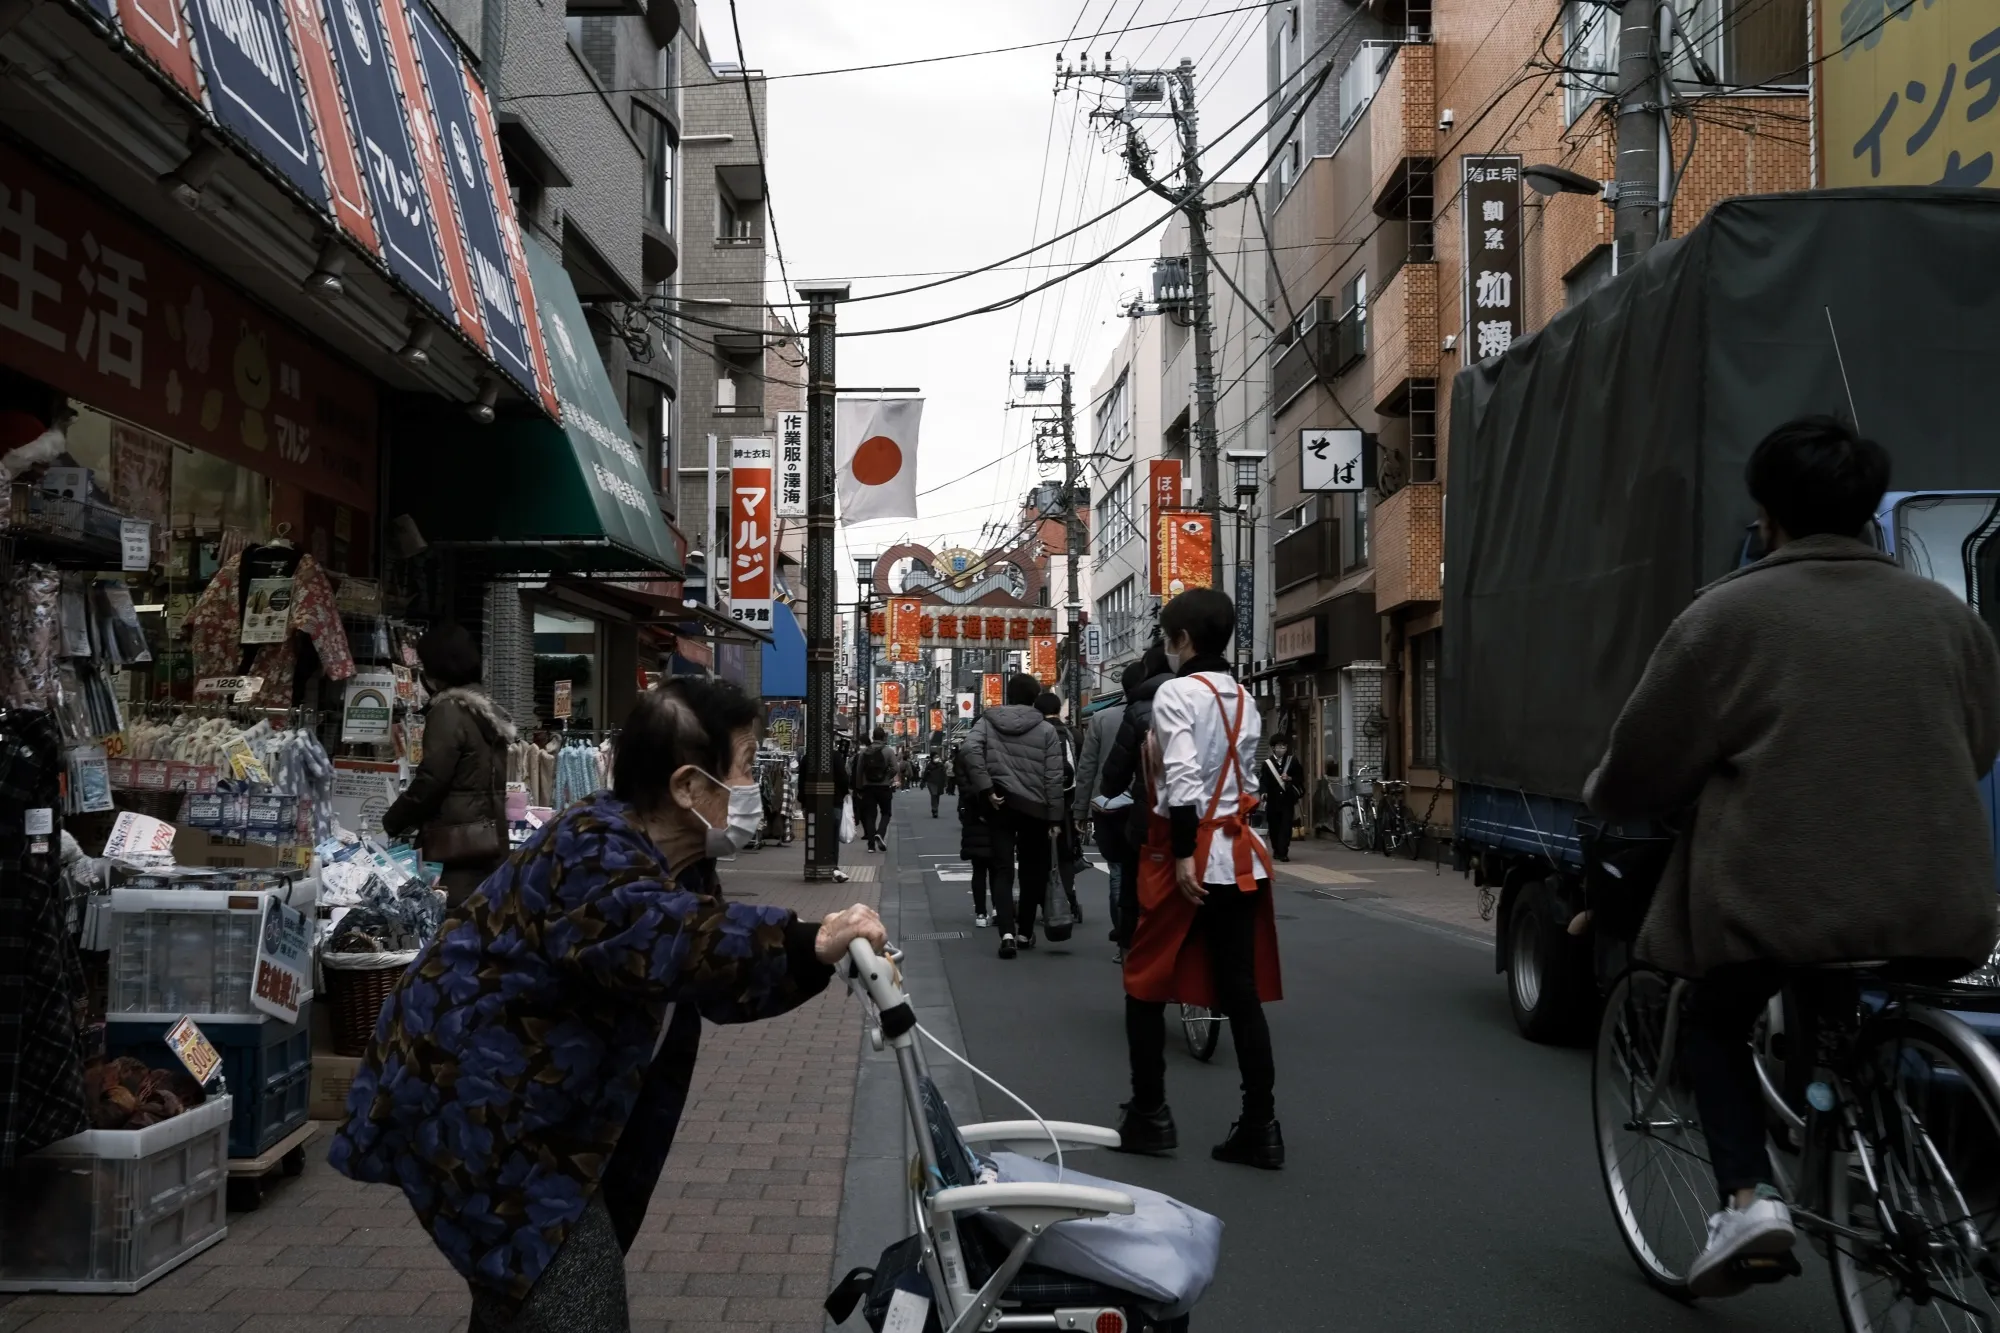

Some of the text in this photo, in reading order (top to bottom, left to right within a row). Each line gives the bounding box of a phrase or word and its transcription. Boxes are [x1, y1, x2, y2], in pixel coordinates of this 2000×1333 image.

[366, 136, 420, 227] マルジ
[274, 413, 310, 464] マルジ
[1307, 437, 1358, 484] そば
[735, 487, 767, 583] マルジ
[732, 608, 770, 622] 3号館
[866, 612, 1052, 640] 巣地蔵通商店街
